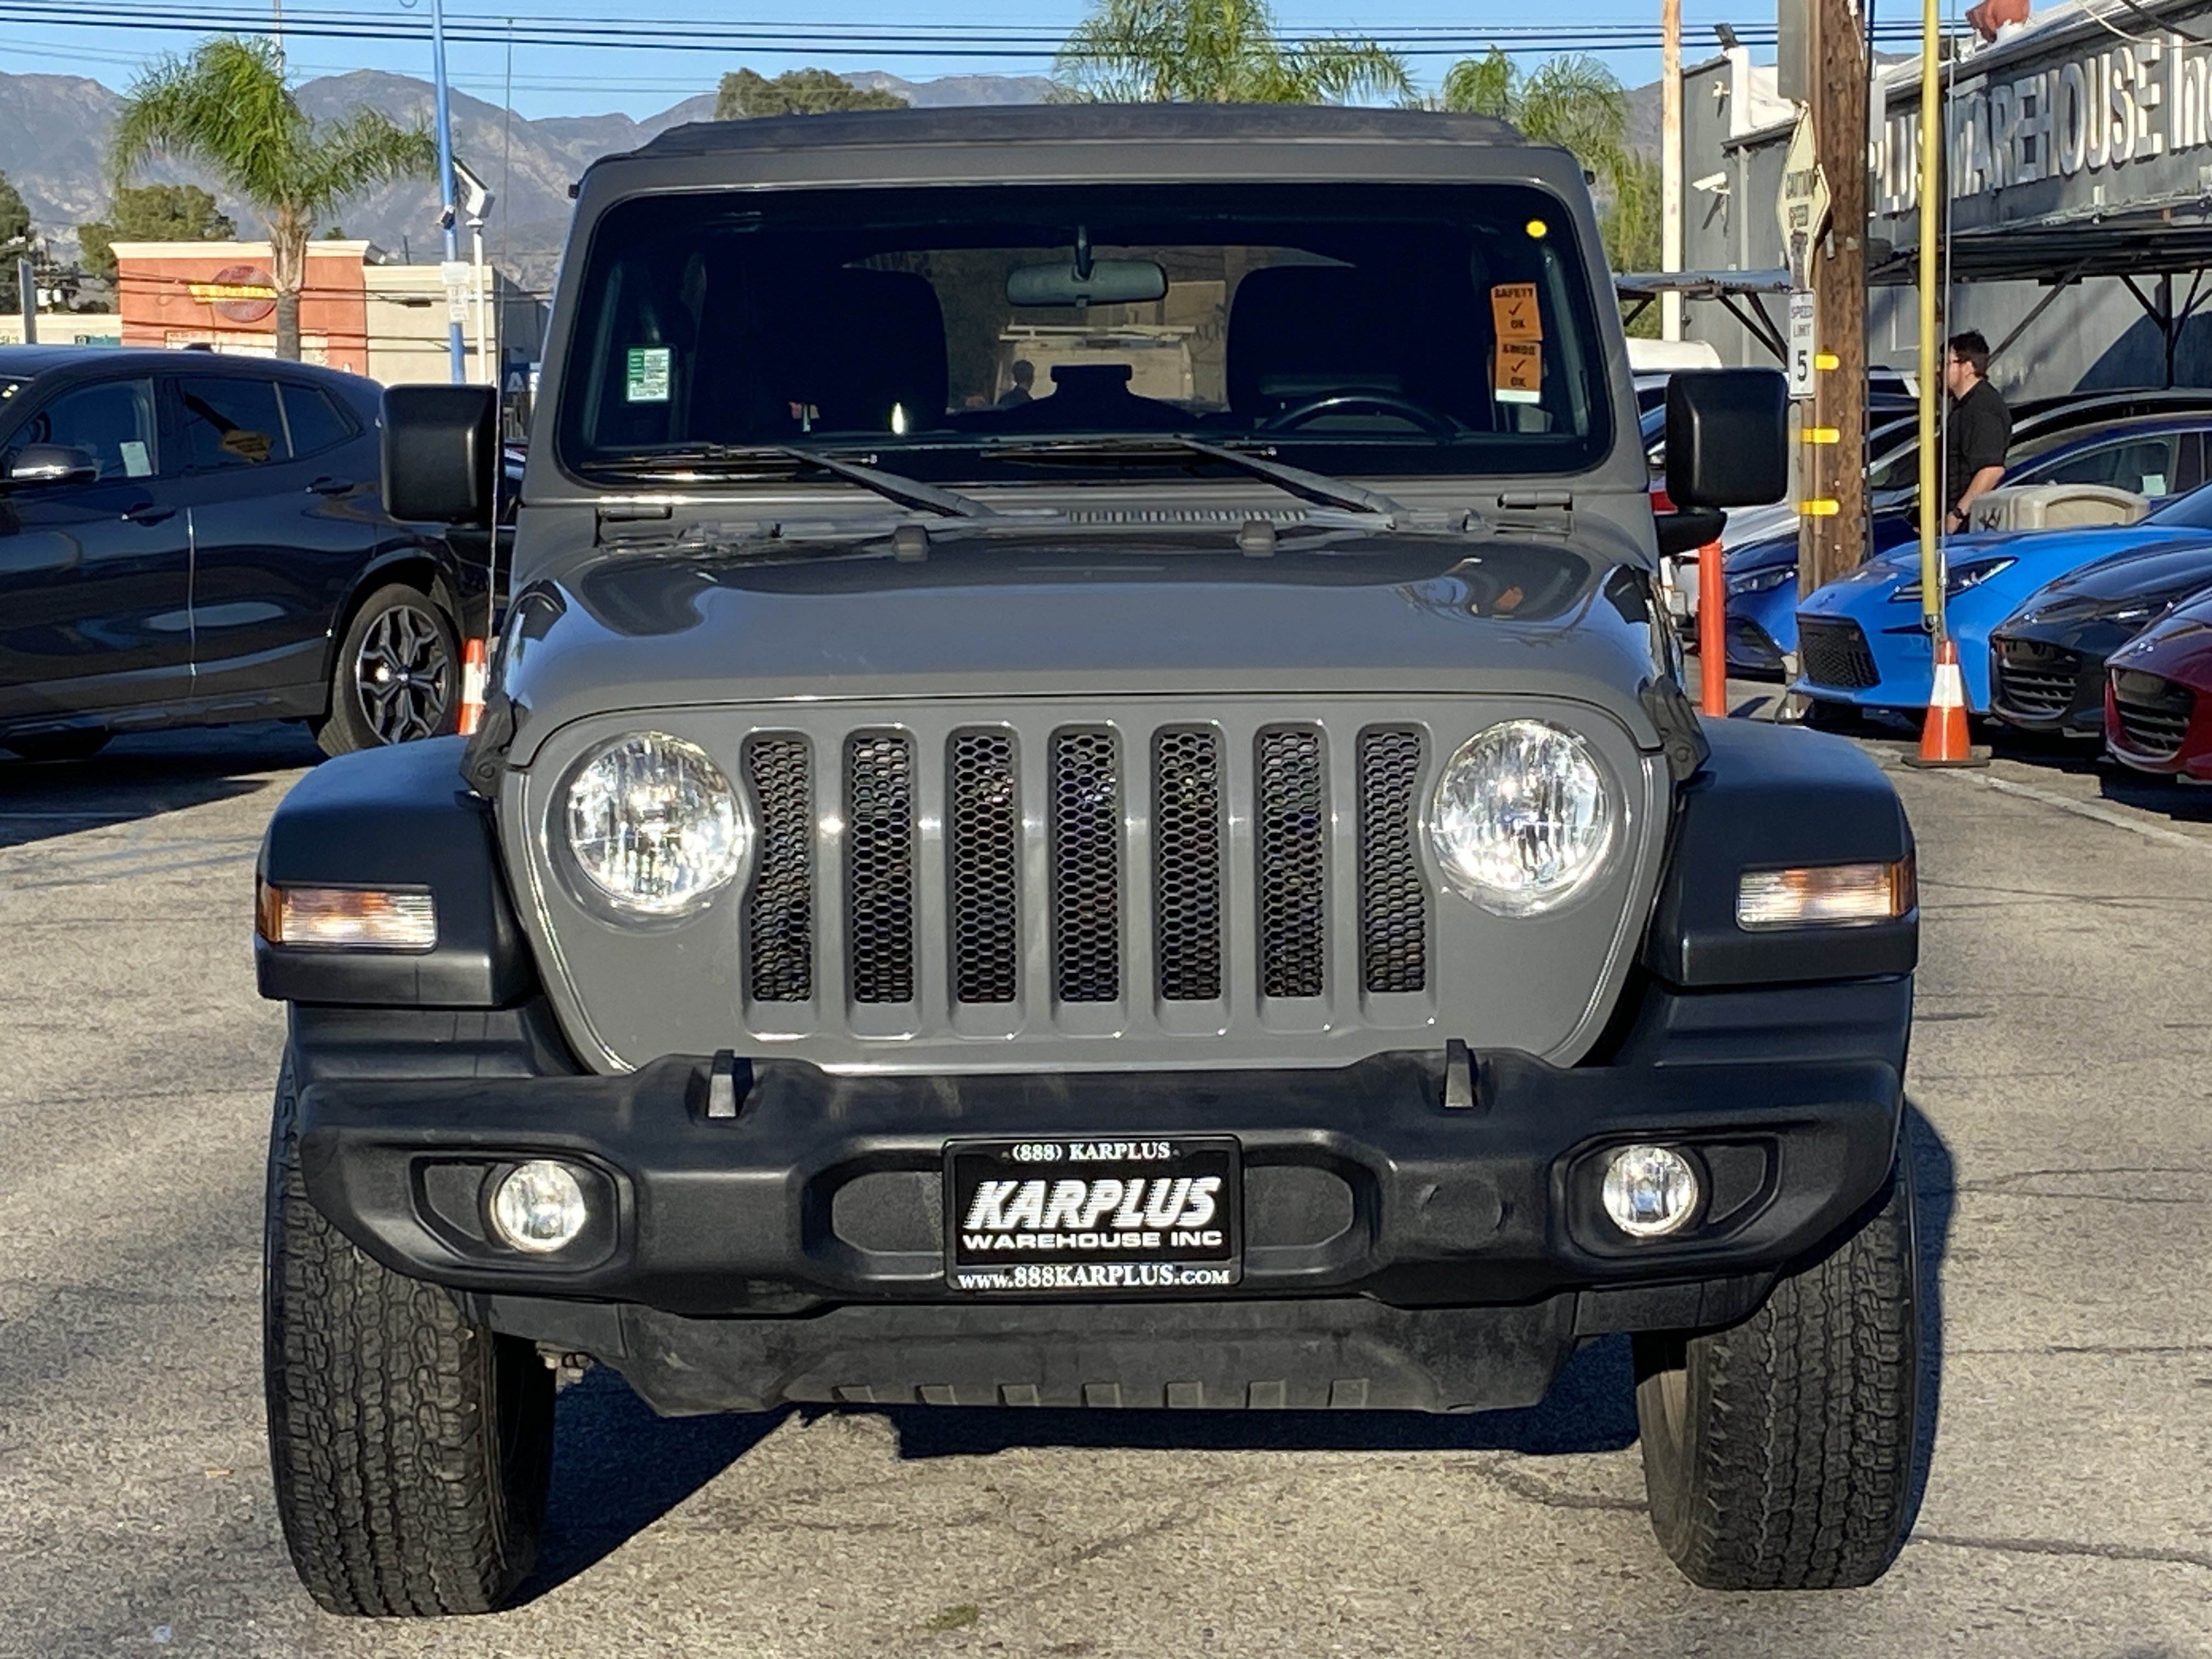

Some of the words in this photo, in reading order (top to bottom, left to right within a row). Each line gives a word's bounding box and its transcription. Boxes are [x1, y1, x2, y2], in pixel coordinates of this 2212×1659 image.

[1944, 38, 2163, 198] WAREHOUSE
[1494, 288, 1533, 298] SAFETY
[1798, 349, 1807, 381] 5
[1012, 1144, 1062, 1162] (888)
[1069, 1142, 1171, 1160] KARPLUS
[963, 1176, 1221, 1230] KARPLUS
[963, 1232, 1161, 1250] WAREHOUSE
[1171, 1231, 1223, 1246] INC
